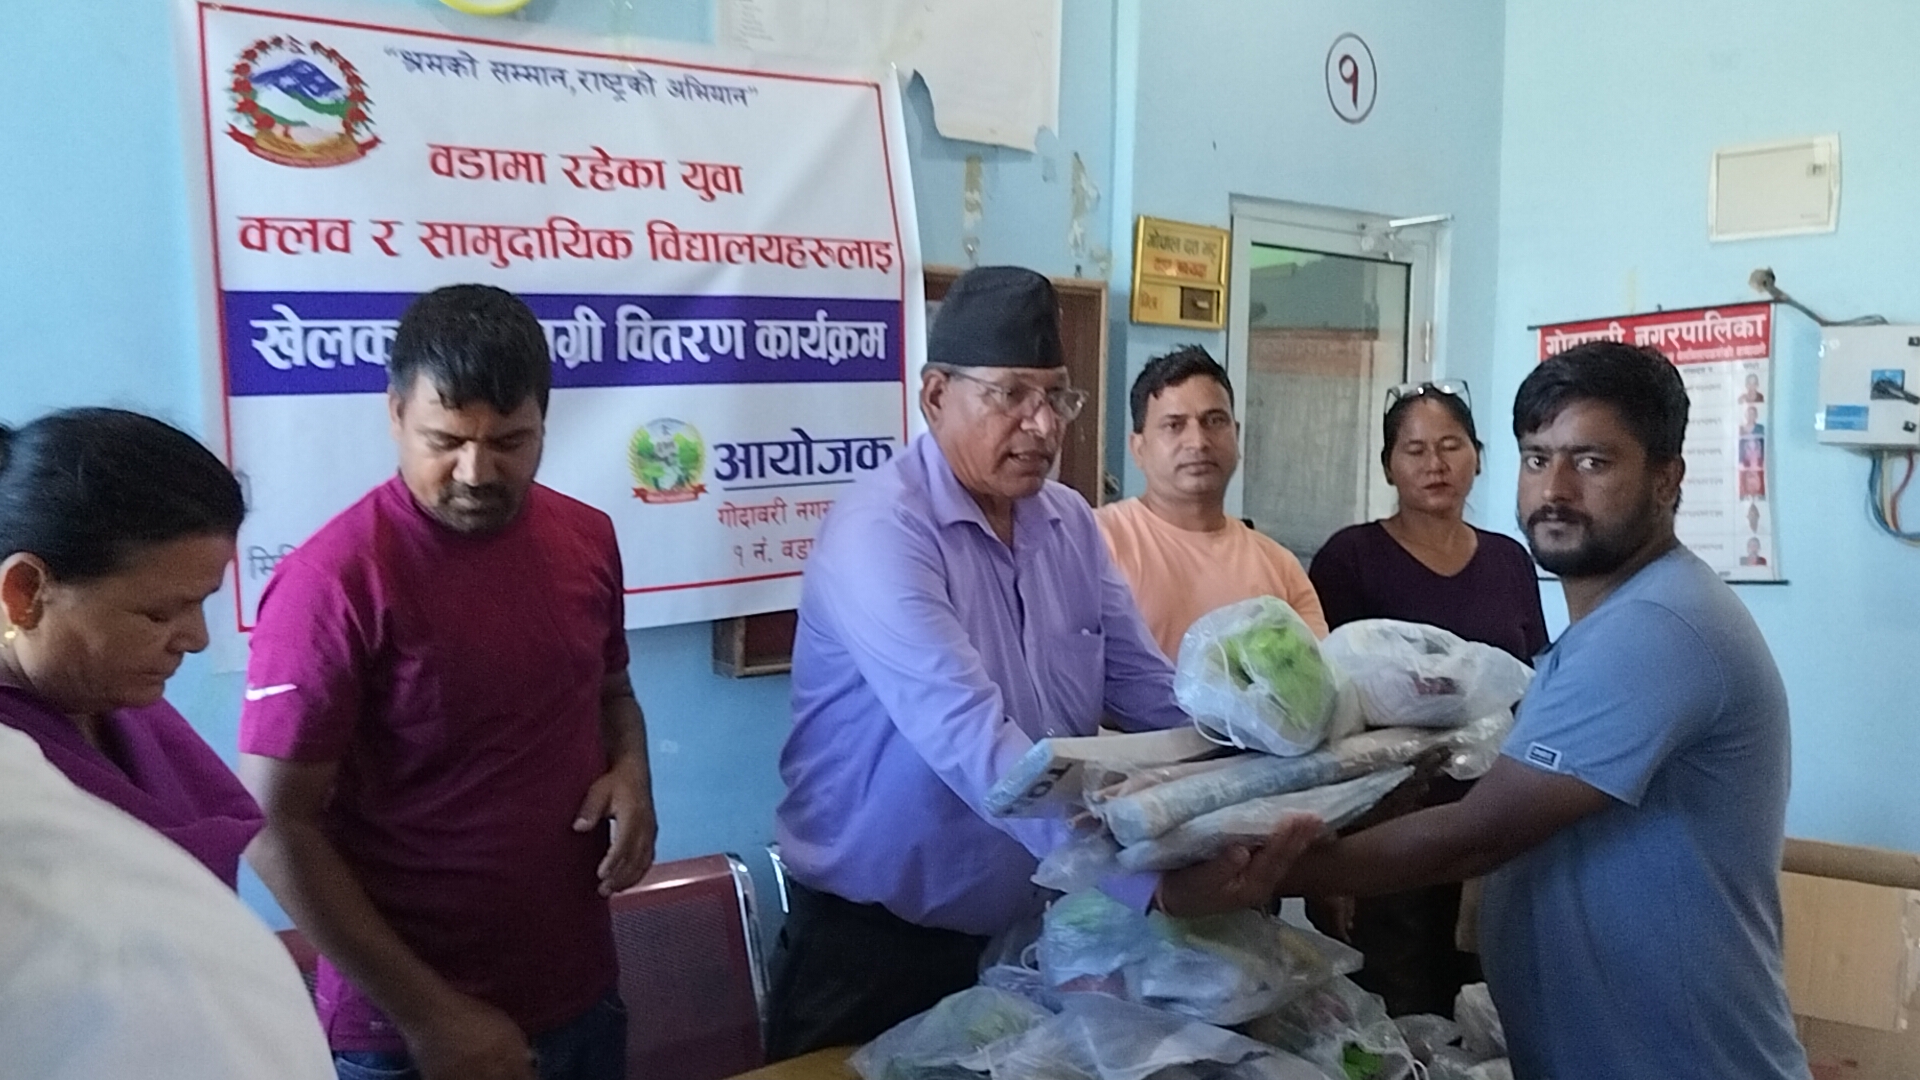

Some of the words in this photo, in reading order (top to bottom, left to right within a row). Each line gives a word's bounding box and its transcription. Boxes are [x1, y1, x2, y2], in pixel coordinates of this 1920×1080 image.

[428, 143, 547, 184] वडामा
[560, 146, 667, 192] रहेका
[677, 159, 744, 202] युवा
[236, 216, 356, 255] क्लव
[369, 218, 404, 257] र
[417, 215, 634, 269] सामुदायिक
[250, 303, 399, 370] खेलक
[616, 304, 747, 364] वितरण
[754, 309, 888, 366] कार्यक्रम
[1634, 310, 1767, 350] नगरपालिका
[713, 427, 896, 481] आयोजक
[717, 496, 788, 529] गोदावरी
[752, 536, 773, 563] नं.
